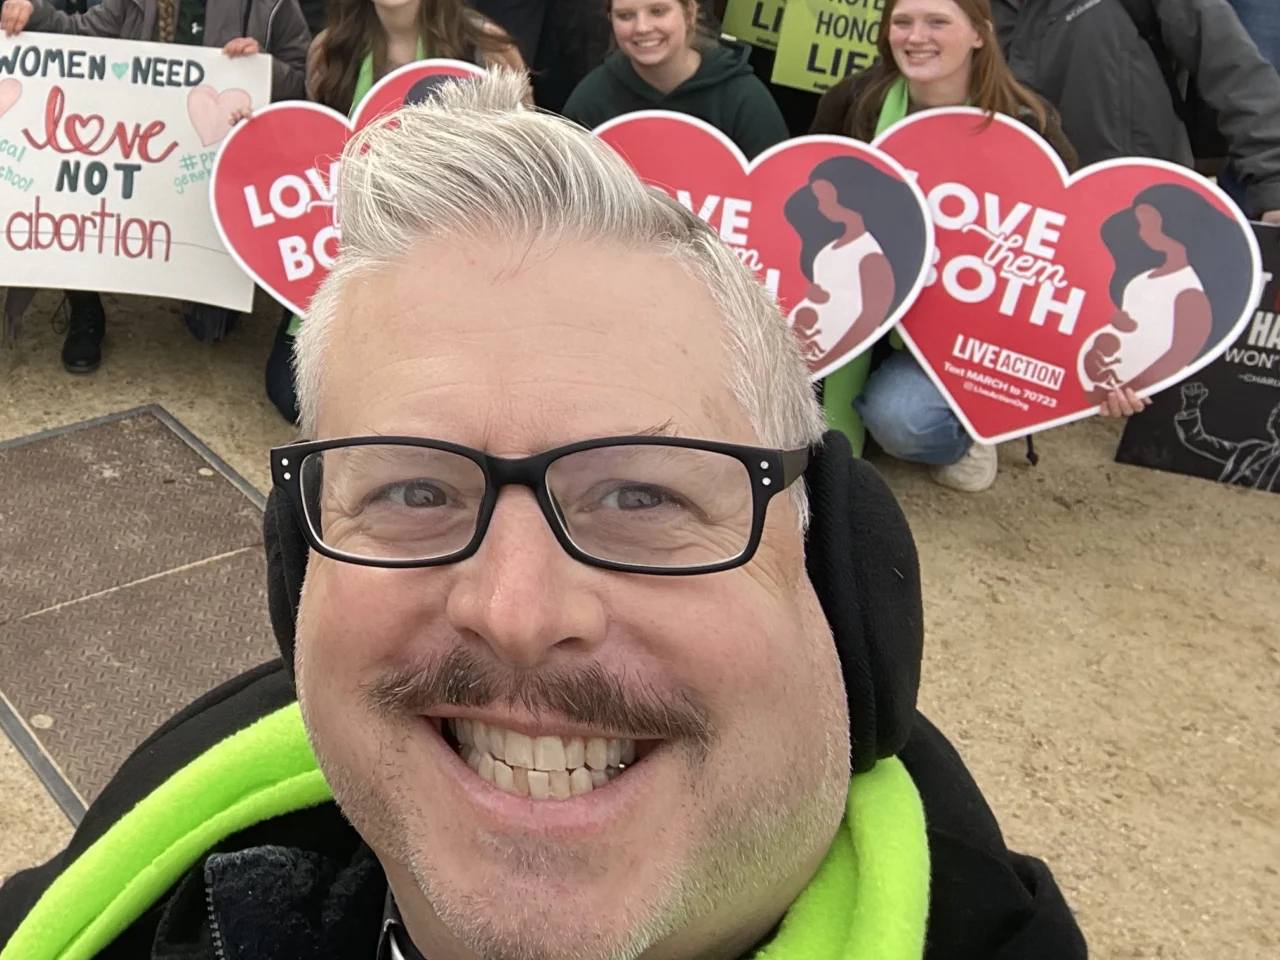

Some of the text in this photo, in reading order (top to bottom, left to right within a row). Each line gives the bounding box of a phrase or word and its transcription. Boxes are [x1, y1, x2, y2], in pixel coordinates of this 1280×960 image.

[751, 1, 783, 33] LI
[815, 11, 880, 46] HONO
[131, 56, 205, 87] NEED
[806, 43, 880, 78] LIF
[21, 85, 179, 163] love
[55, 159, 143, 200] NOT
[243, 161, 341, 229] LOV
[5, 195, 171, 262] abortion
[925, 182, 1067, 260] OVE
[278, 225, 342, 282] BO
[961, 223, 1068, 288] them
[925, 245, 1087, 336] OTH
[944, 361, 1058, 409] Text MARCH to 70723
[952, 333, 1062, 388] LIVE ACTION
[1224, 347, 1280, 369] WON'
